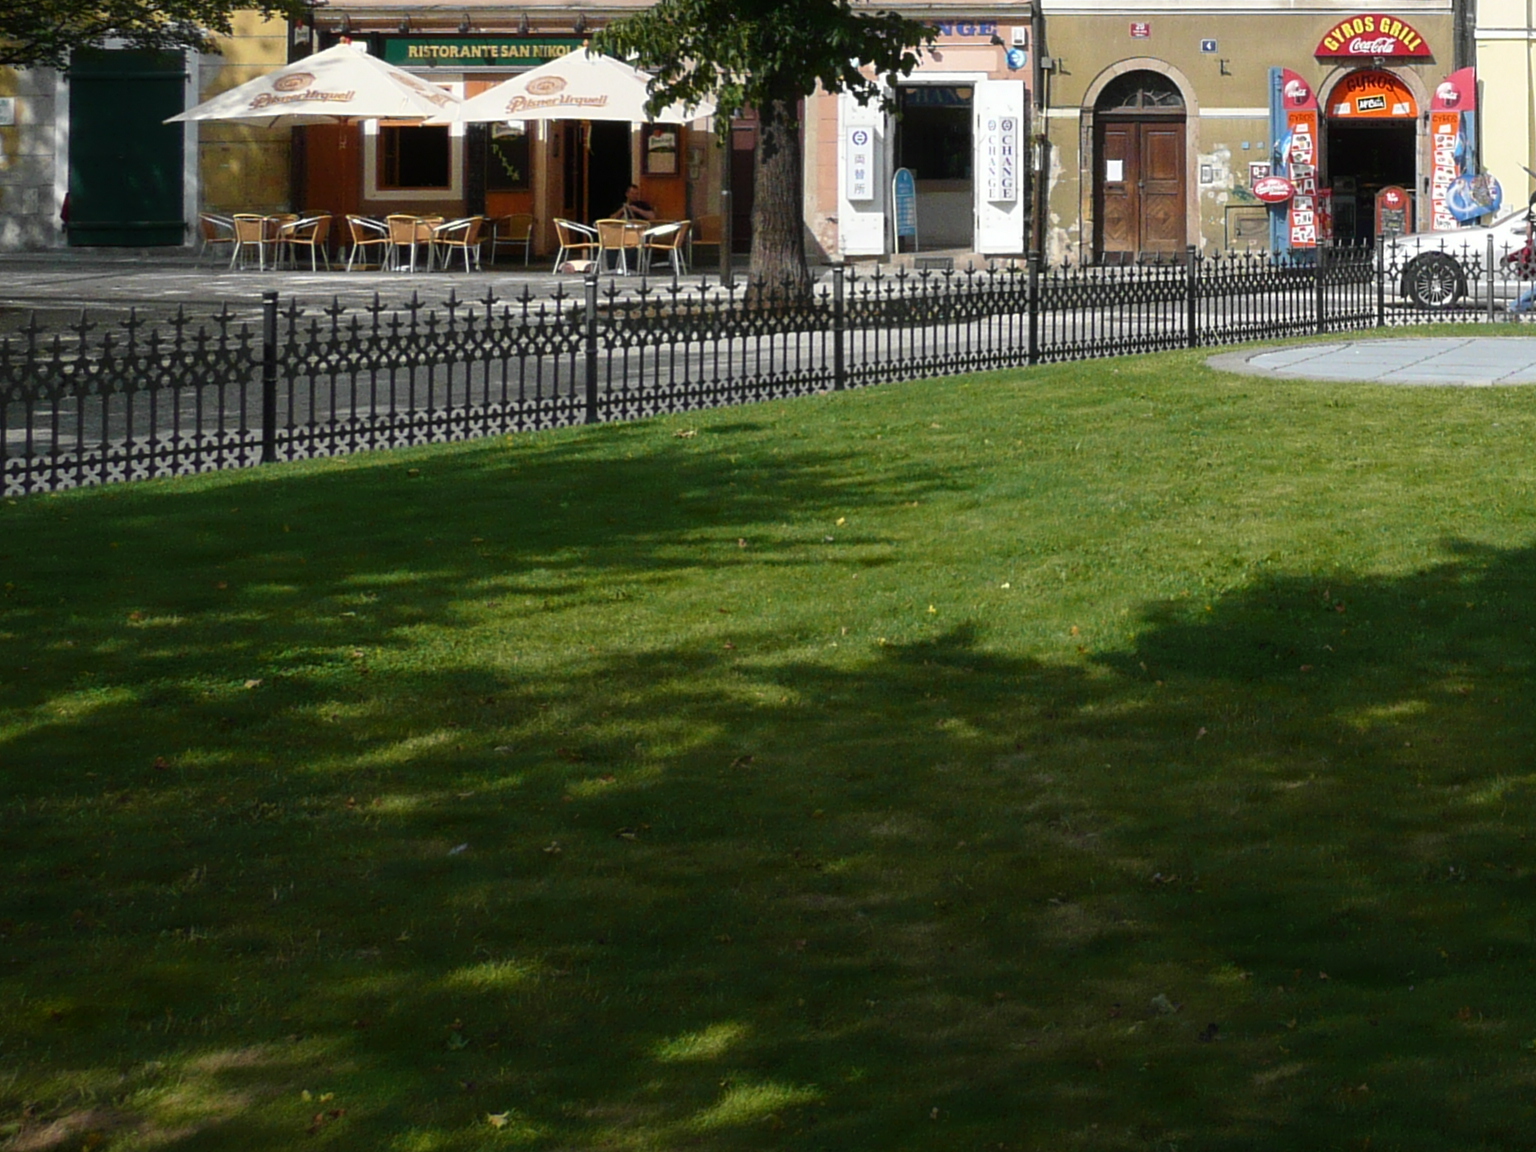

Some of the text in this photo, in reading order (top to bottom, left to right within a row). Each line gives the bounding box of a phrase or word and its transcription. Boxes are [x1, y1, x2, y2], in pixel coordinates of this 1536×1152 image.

[1324, 16, 1422, 52] GYROS GRILL
[408, 45, 500, 59] RISTORANTE
[501, 45, 531, 58] SAN
[1347, 74, 1396, 93] GYROS
[304, 89, 356, 103] Urquell
[505, 94, 609, 115] Pilsner Urquell
[987, 134, 997, 199] CHANGE
[1001, 134, 1014, 199] CHANGE
